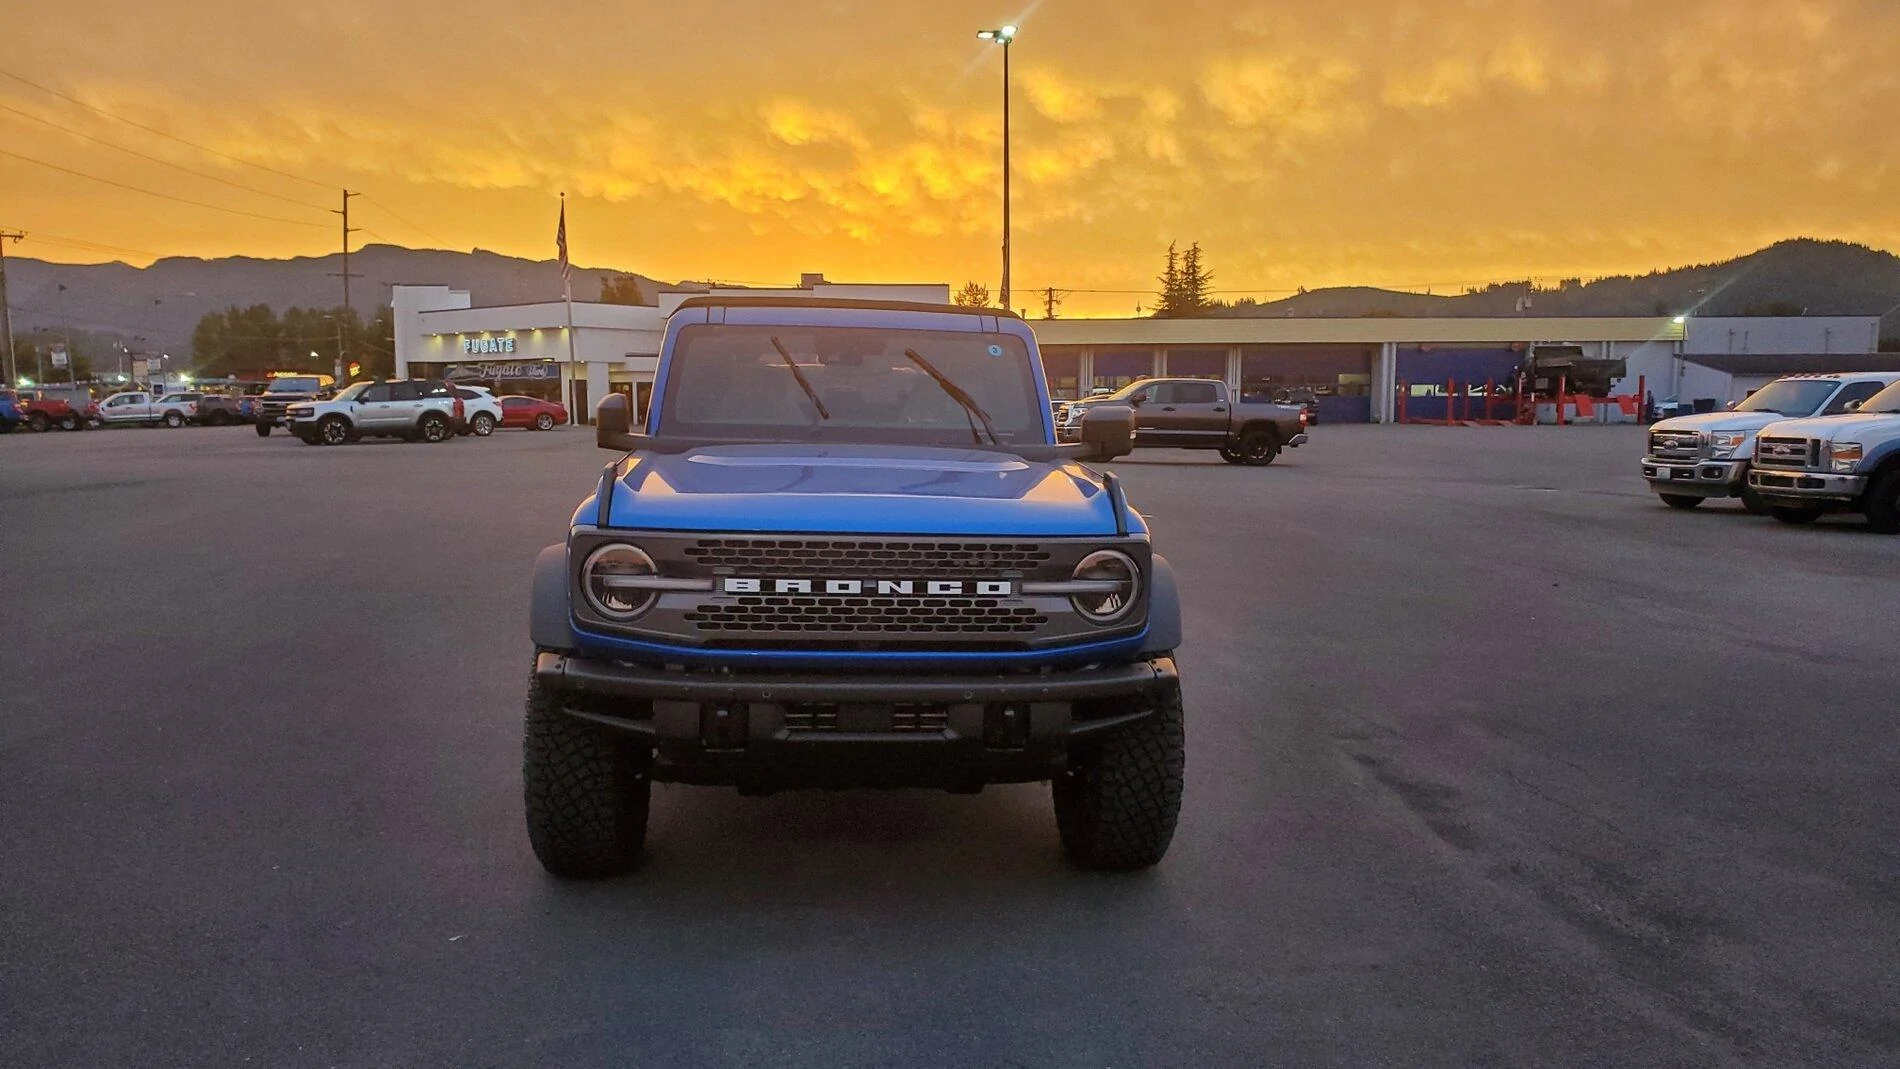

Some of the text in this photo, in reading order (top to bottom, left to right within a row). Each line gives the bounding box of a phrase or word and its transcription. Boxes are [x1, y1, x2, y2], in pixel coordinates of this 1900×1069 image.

[464, 337, 514, 353] FUGATE
[479, 361, 522, 381] Fugate
[724, 578, 1011, 595] BRONCO
